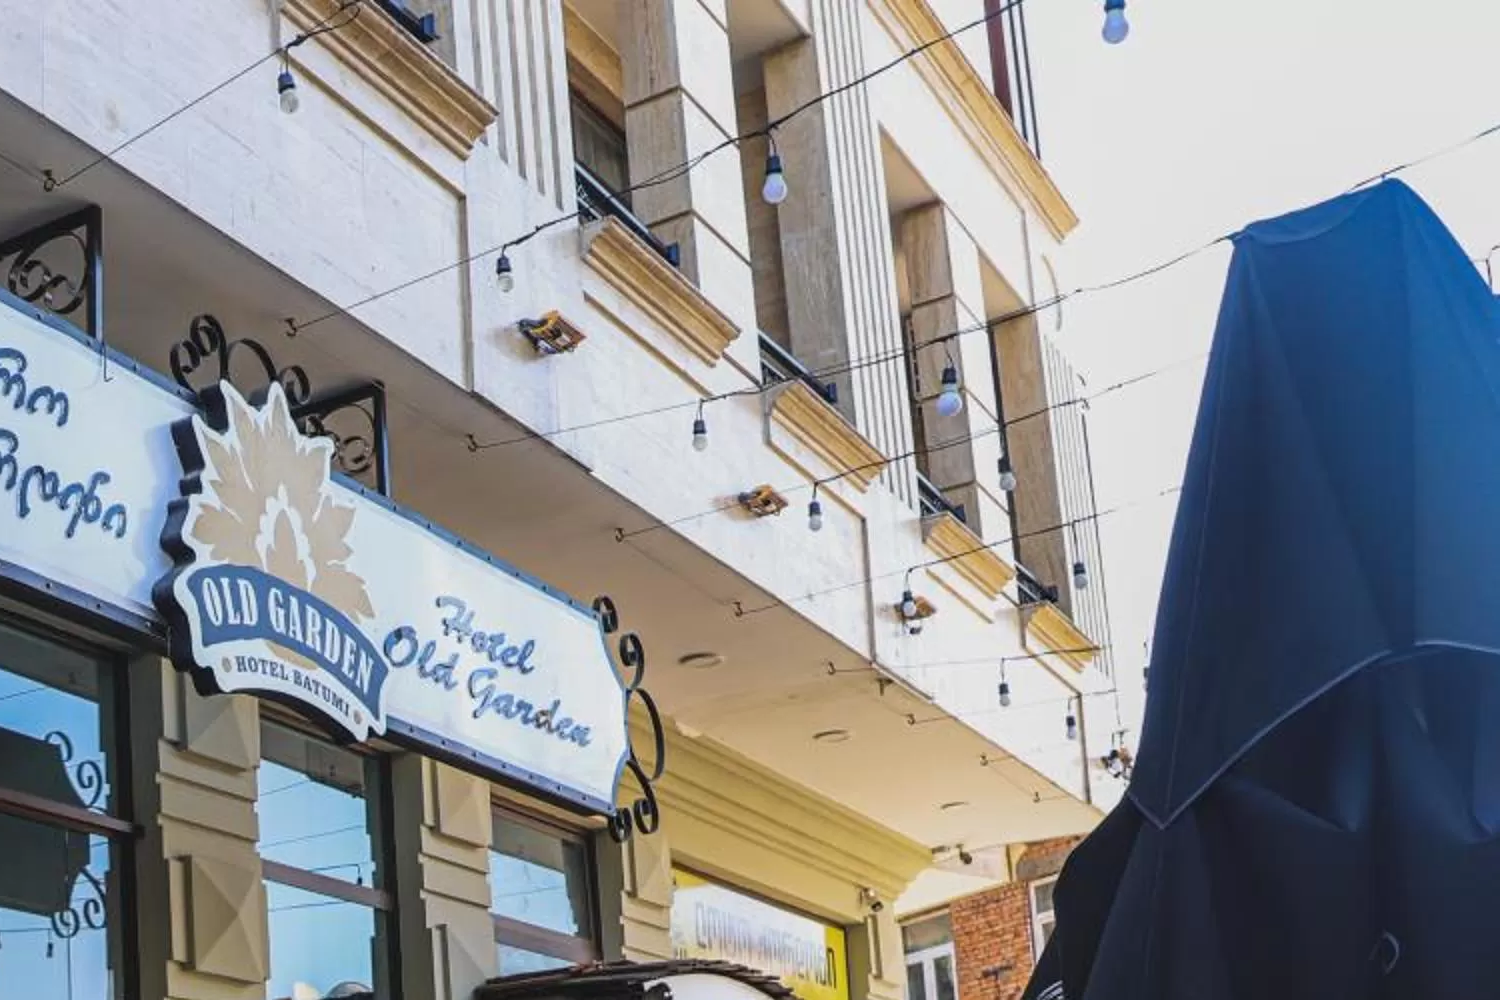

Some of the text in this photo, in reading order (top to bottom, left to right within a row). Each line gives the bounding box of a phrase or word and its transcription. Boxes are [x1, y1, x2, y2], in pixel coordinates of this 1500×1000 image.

[201, 576, 376, 697] OLD GARDEN
[235, 654, 352, 716] HOTEL BATUMI
[435, 595, 536, 675] Hotel
[383, 625, 593, 749] Old Garden
